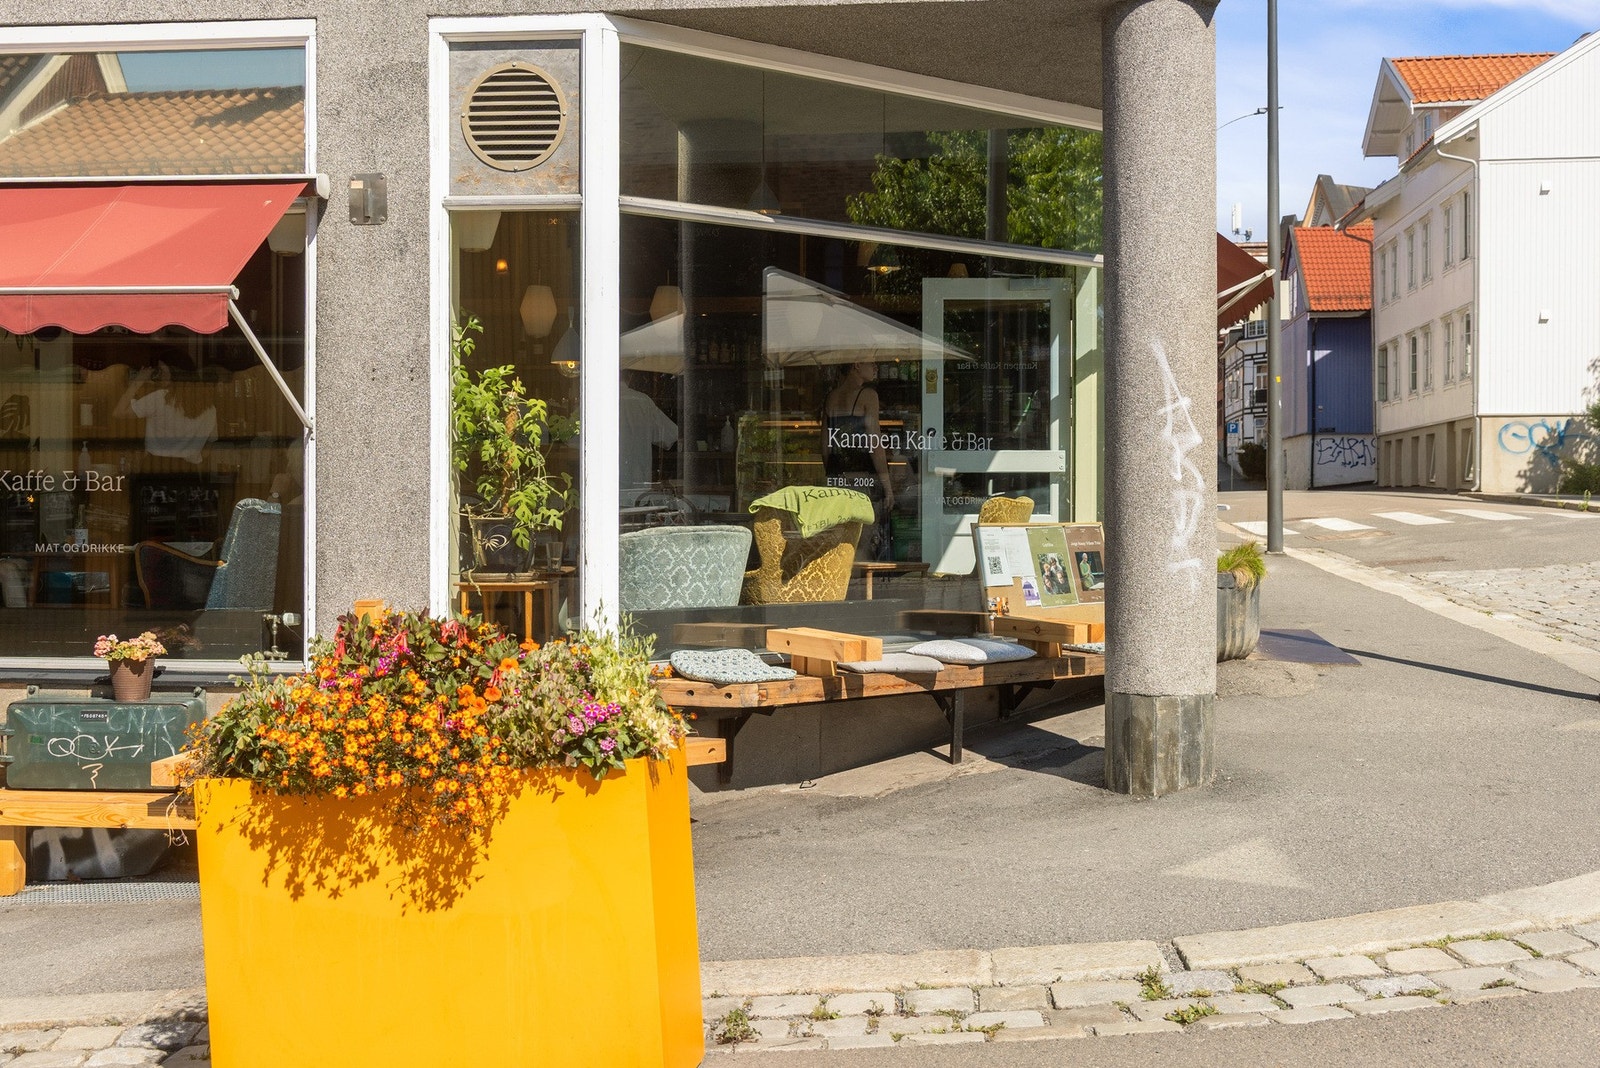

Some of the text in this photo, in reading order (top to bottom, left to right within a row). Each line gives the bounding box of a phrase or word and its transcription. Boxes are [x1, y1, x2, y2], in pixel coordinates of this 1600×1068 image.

[827, 427, 994, 453] Kampen Kafe & Bar
[62, 470, 80, 491] &
[85, 470, 125, 491] Bar
[827, 477, 874, 487] ETBL. 2002
[35, 543, 125, 553] MAT OG DRIKKE
